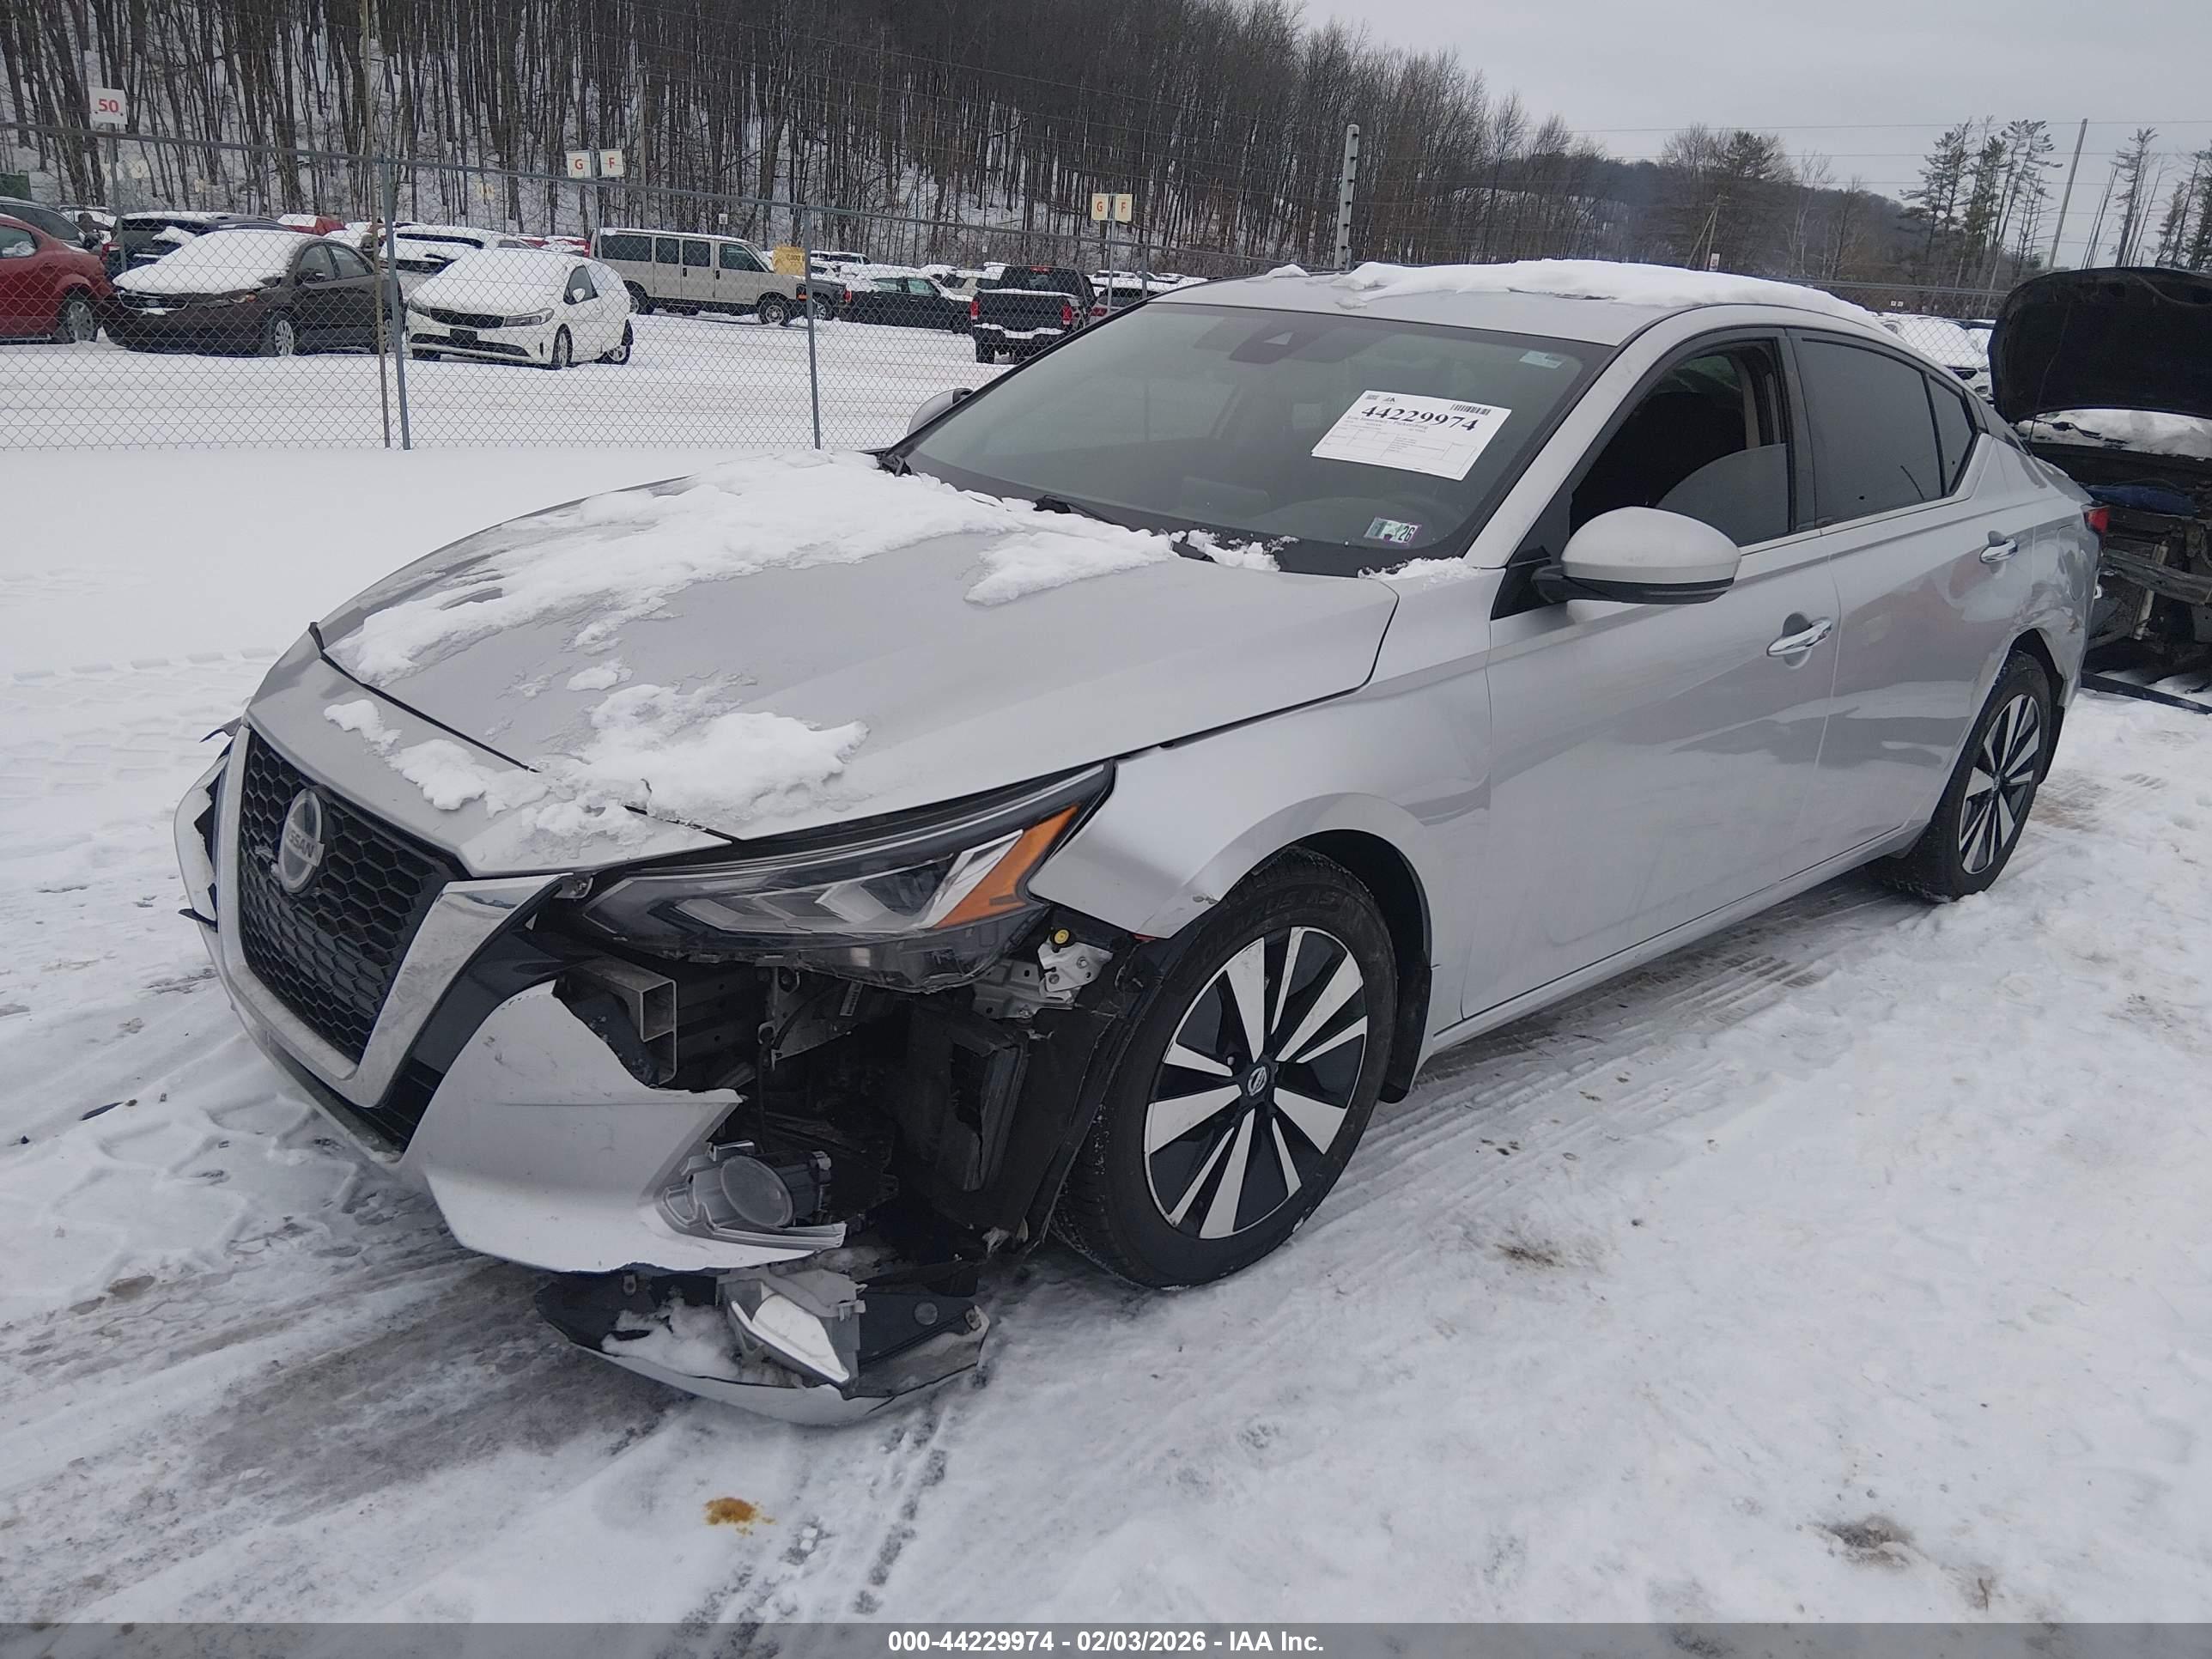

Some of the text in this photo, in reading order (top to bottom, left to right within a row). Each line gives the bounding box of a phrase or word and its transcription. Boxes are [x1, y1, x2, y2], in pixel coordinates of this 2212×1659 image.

[99, 99, 118, 112] 50
[574, 158, 583, 170] G
[609, 157, 615, 169] F
[1097, 201, 1103, 212] G
[1121, 202, 1126, 213] F
[1361, 405, 1479, 431] 44229974
[1398, 526, 1416, 542] 26
[287, 827, 316, 859] SSAN
